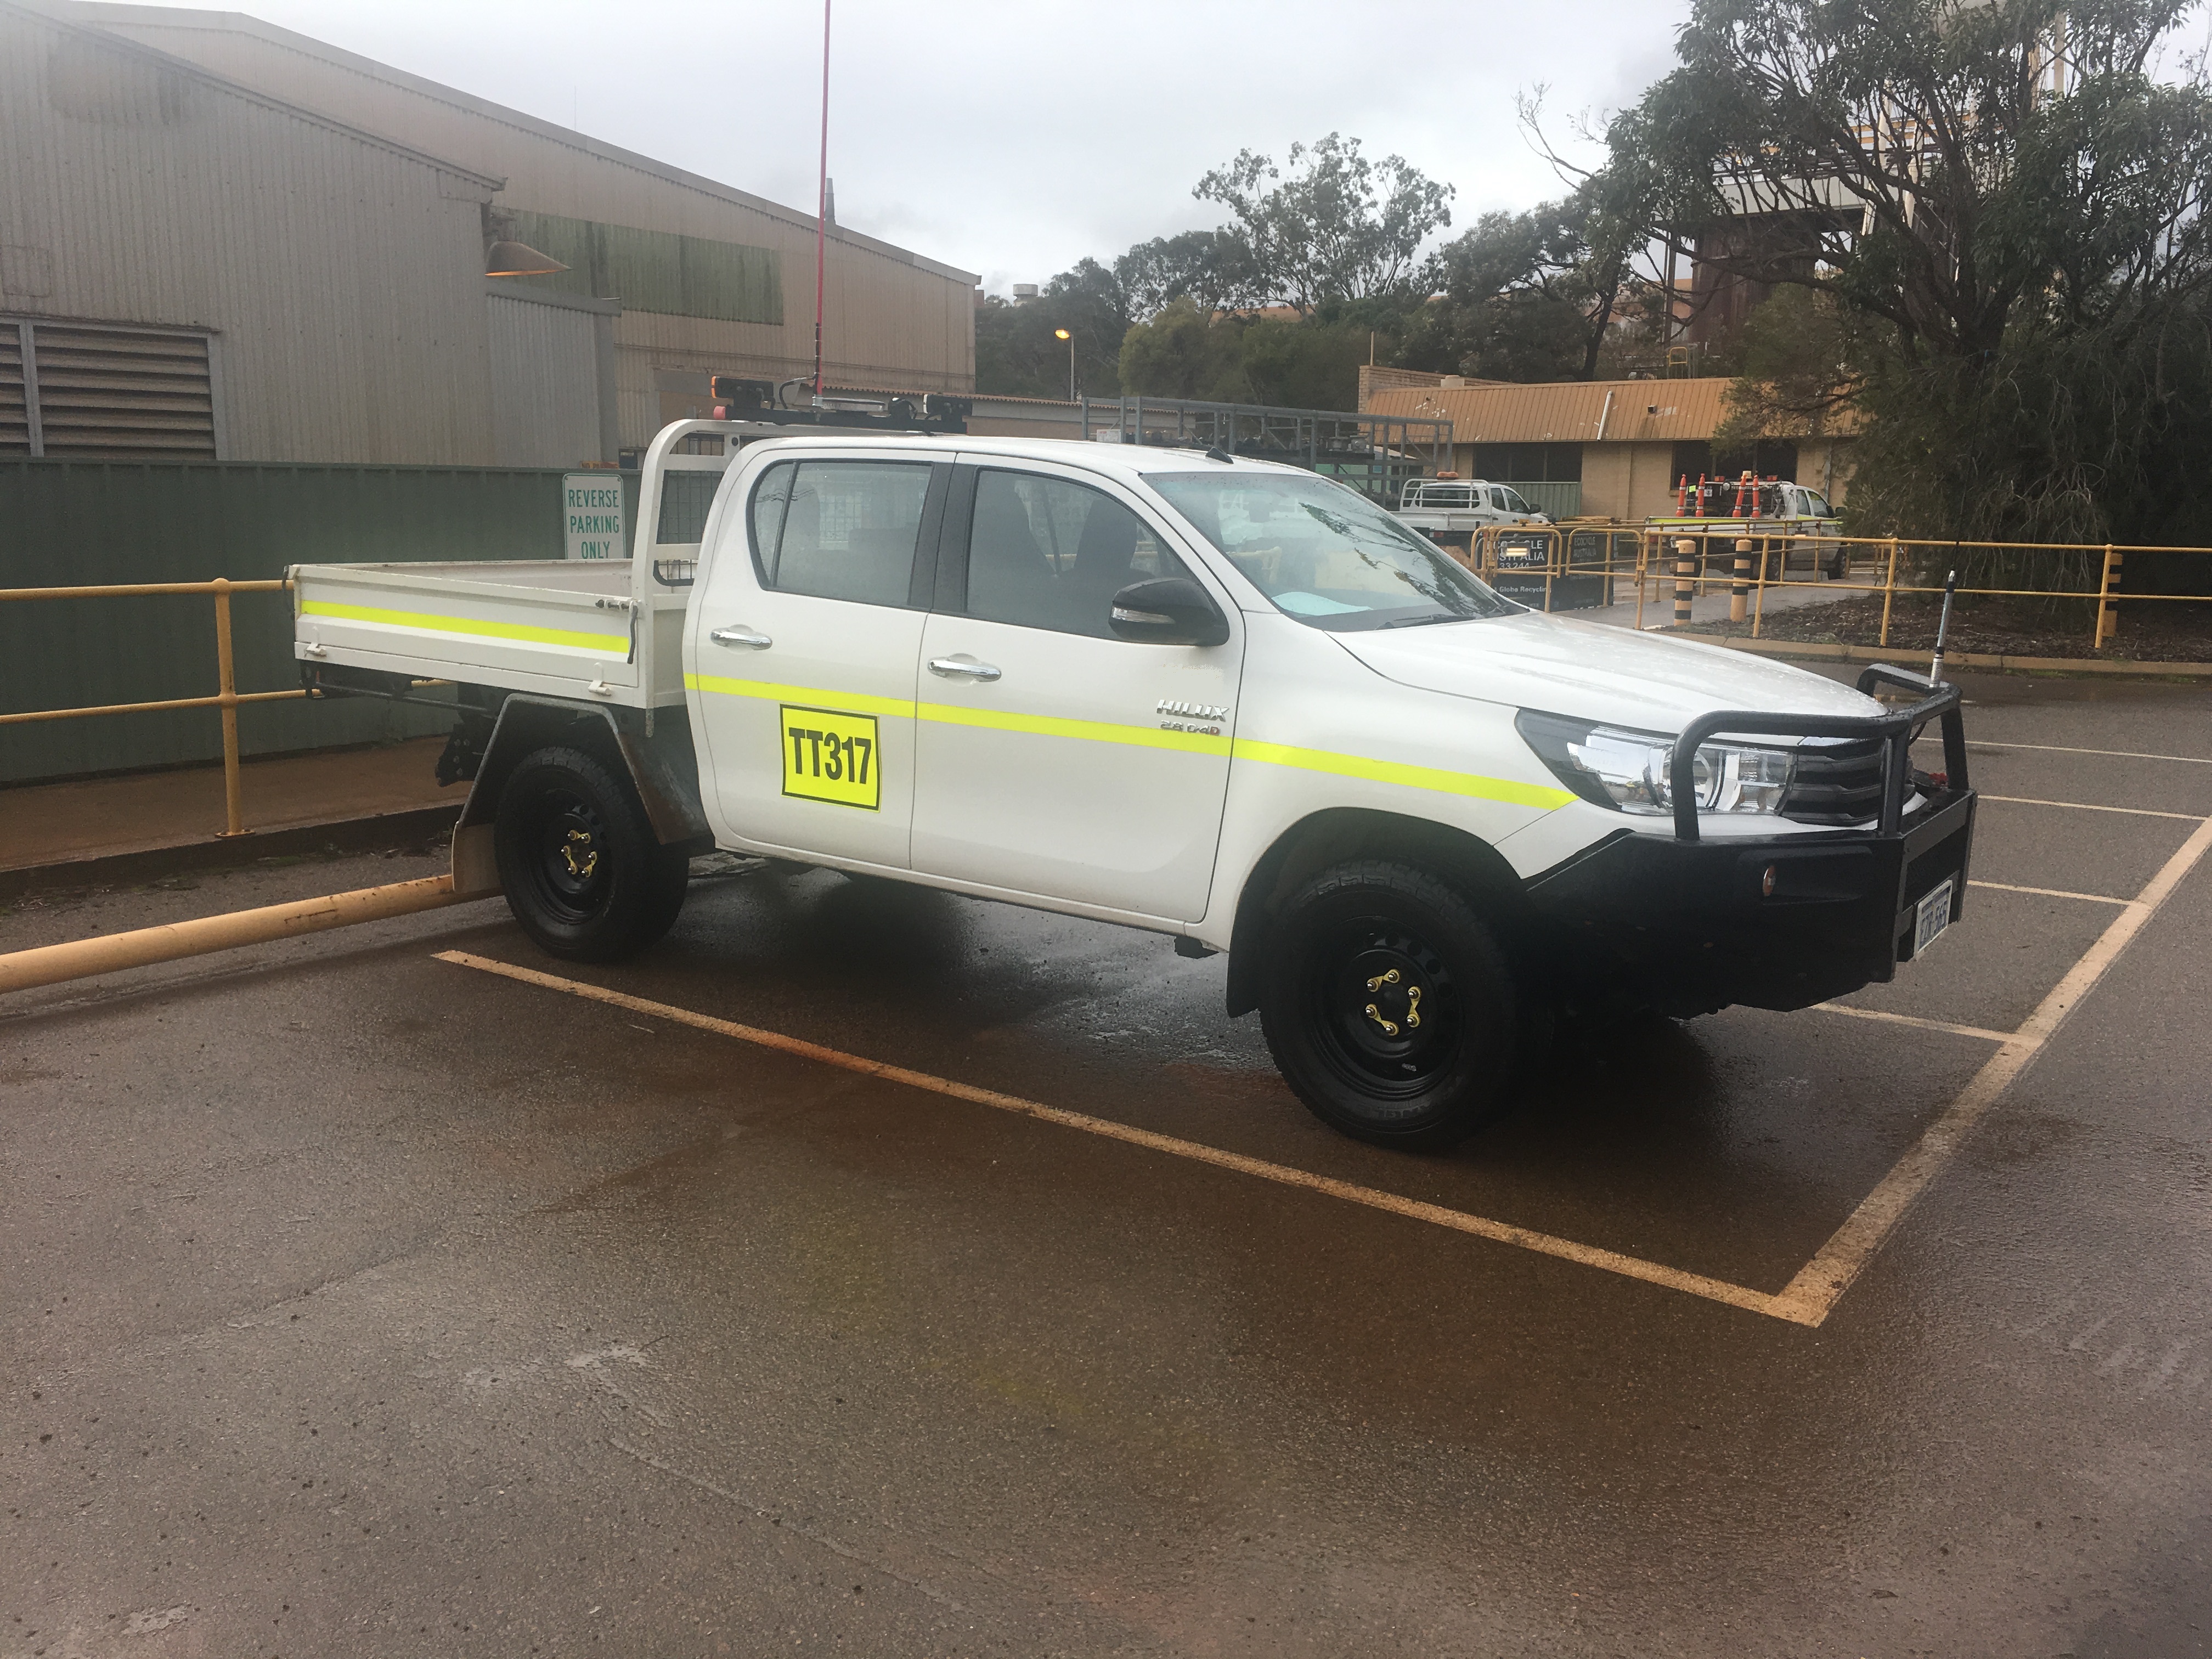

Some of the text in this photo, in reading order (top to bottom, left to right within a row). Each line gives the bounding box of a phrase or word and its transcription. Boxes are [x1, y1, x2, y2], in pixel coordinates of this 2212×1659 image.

[568, 489, 619, 508] REVERSE
[570, 515, 619, 534] PARKING
[581, 541, 610, 559] ONLY
[1156, 699, 1229, 723] HILUX
[788, 726, 872, 785] TT317
